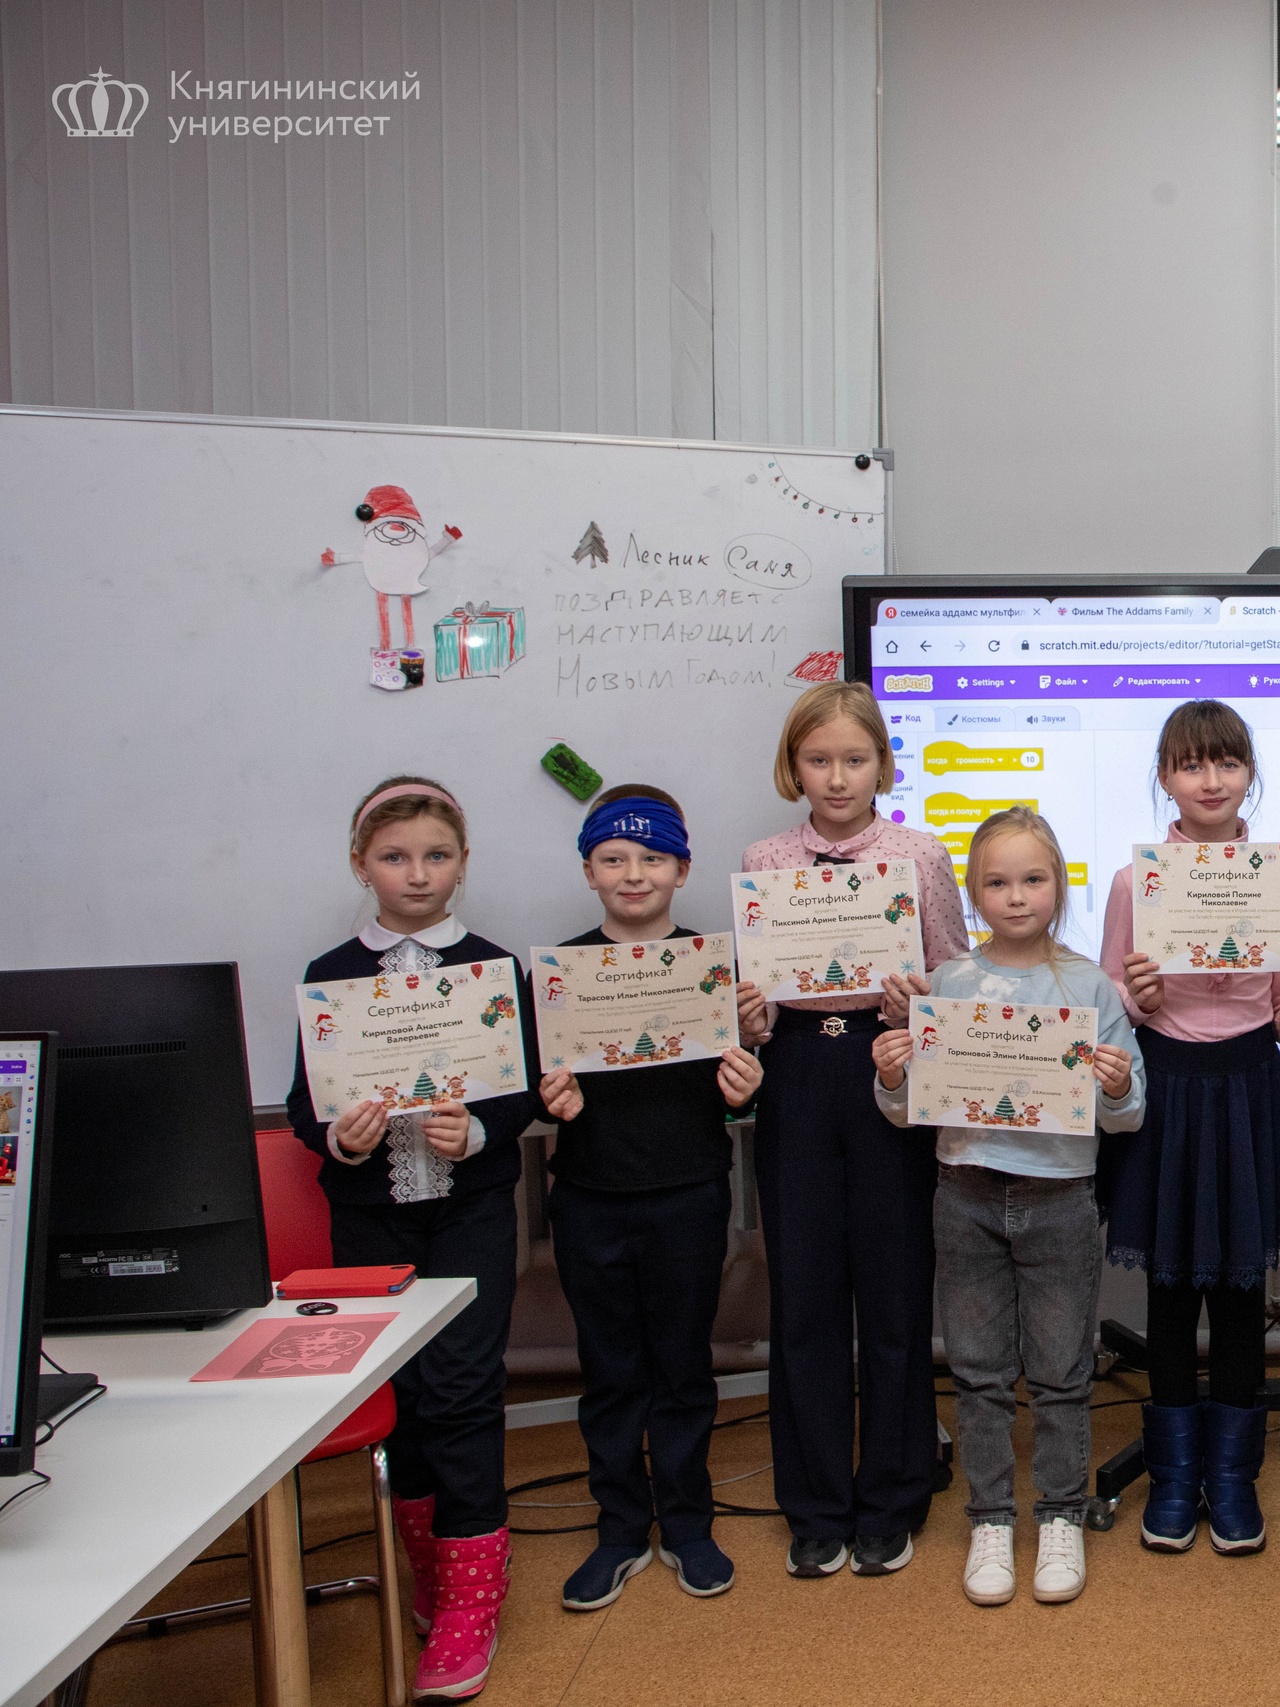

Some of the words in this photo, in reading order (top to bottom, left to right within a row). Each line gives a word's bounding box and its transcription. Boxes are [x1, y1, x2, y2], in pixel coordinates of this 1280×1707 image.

[622, 531, 710, 568] Лесник
[900, 608, 940, 617] семейка
[942, 608, 979, 618] аддамс
[1071, 606, 1104, 616] Фильм
[1105, 606, 1124, 615] The
[1125, 606, 1162, 615] Addams
[1164, 606, 1194, 617] Family
[1242, 606, 1276, 615] Scratch
[557, 621, 788, 647] НАСТУПАЮЩИМ
[972, 678, 1005, 688] Settings
[1055, 677, 1077, 686] Файл
[1127, 677, 1190, 686] Редактировать
[905, 714, 921, 723] Код
[961, 715, 1001, 723] Костюмы
[1041, 714, 1066, 723] Звуки
[1026, 755, 1035, 763] 10
[1189, 869, 1260, 881] Сертификат
[789, 894, 859, 907] Сертификат
[1187, 891, 1230, 899] Кириловой
[772, 917, 810, 927] Пиксиной
[812, 916, 837, 924] Арине
[838, 913, 881, 922] Евгеньевне
[596, 968, 673, 983] Сертификат
[577, 994, 615, 1003] Тарасову
[641, 986, 695, 997] Николаевичу
[368, 1000, 452, 1018] Сертификат
[362, 1025, 414, 1038] Кириловой
[416, 1020, 463, 1031] Анастасии
[967, 1028, 1038, 1042] Сертификат
[387, 1031, 440, 1044] Валерьевне
[948, 1048, 991, 1058] Горюновой
[993, 1051, 1017, 1060] Элине
[1019, 1054, 1057, 1062] Ивановне
